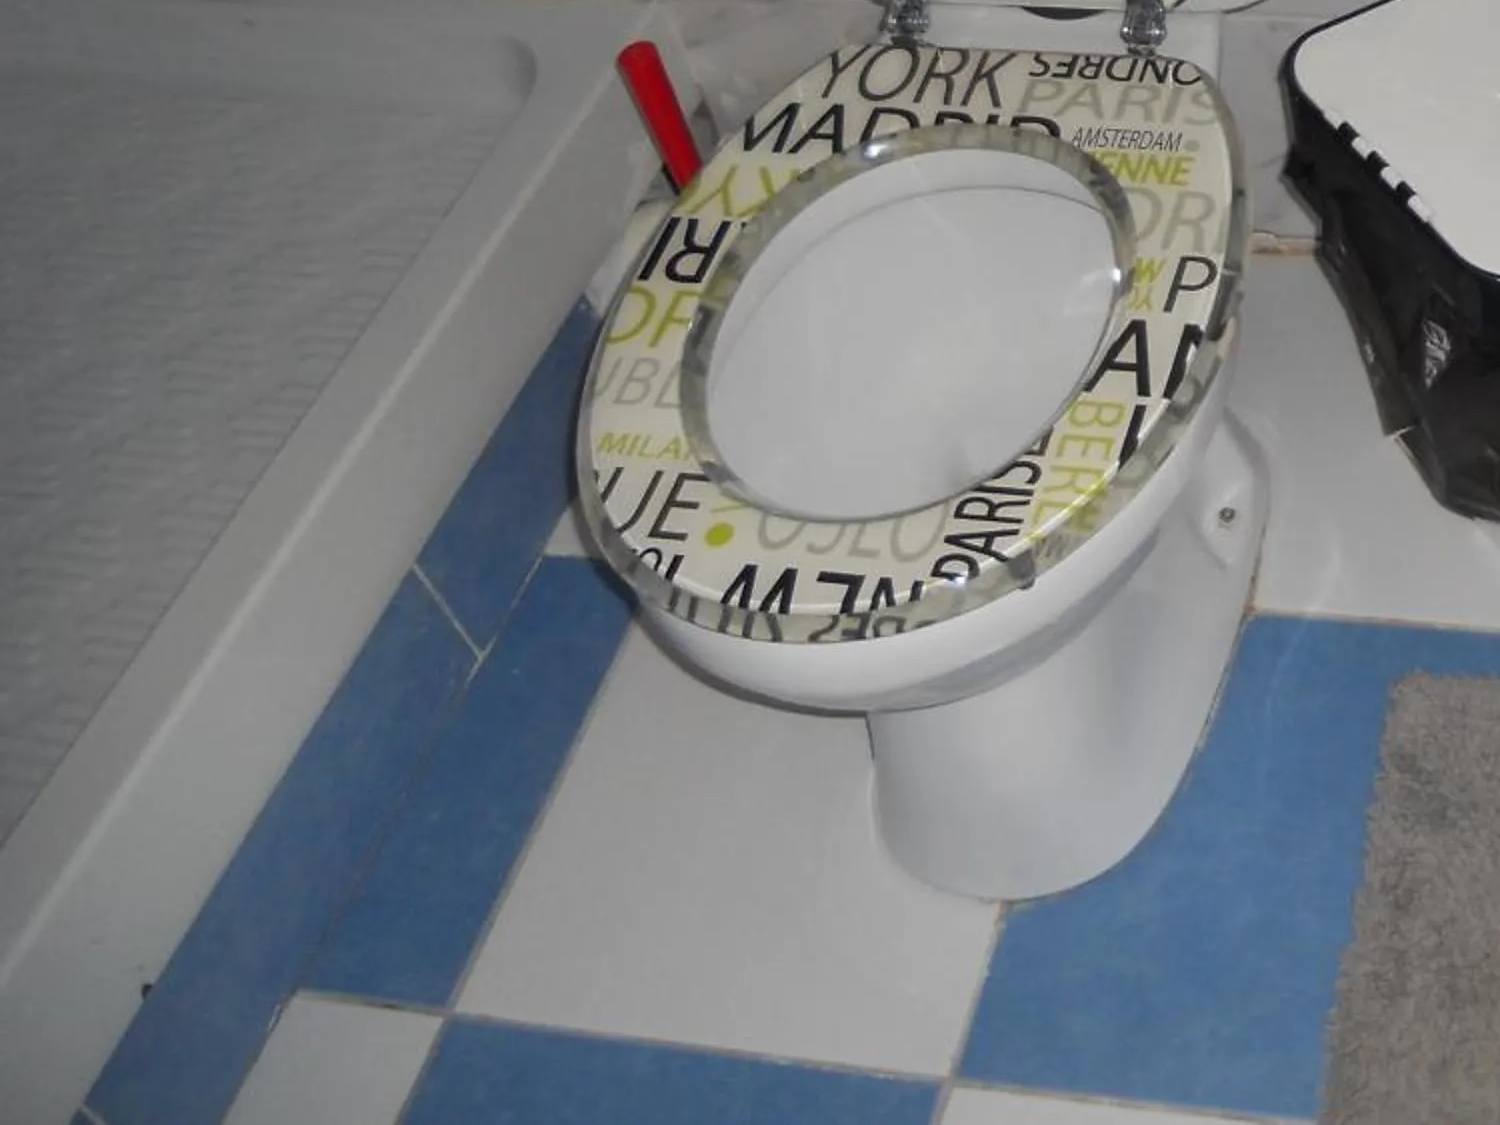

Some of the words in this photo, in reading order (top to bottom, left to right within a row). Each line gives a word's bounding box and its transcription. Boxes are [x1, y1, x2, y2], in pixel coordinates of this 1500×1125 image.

[823, 44, 1018, 108] YORK
[1018, 79, 1219, 125] PARIS
[1071, 126, 1184, 153] AMSTERDAM
[597, 430, 692, 461] MILA
